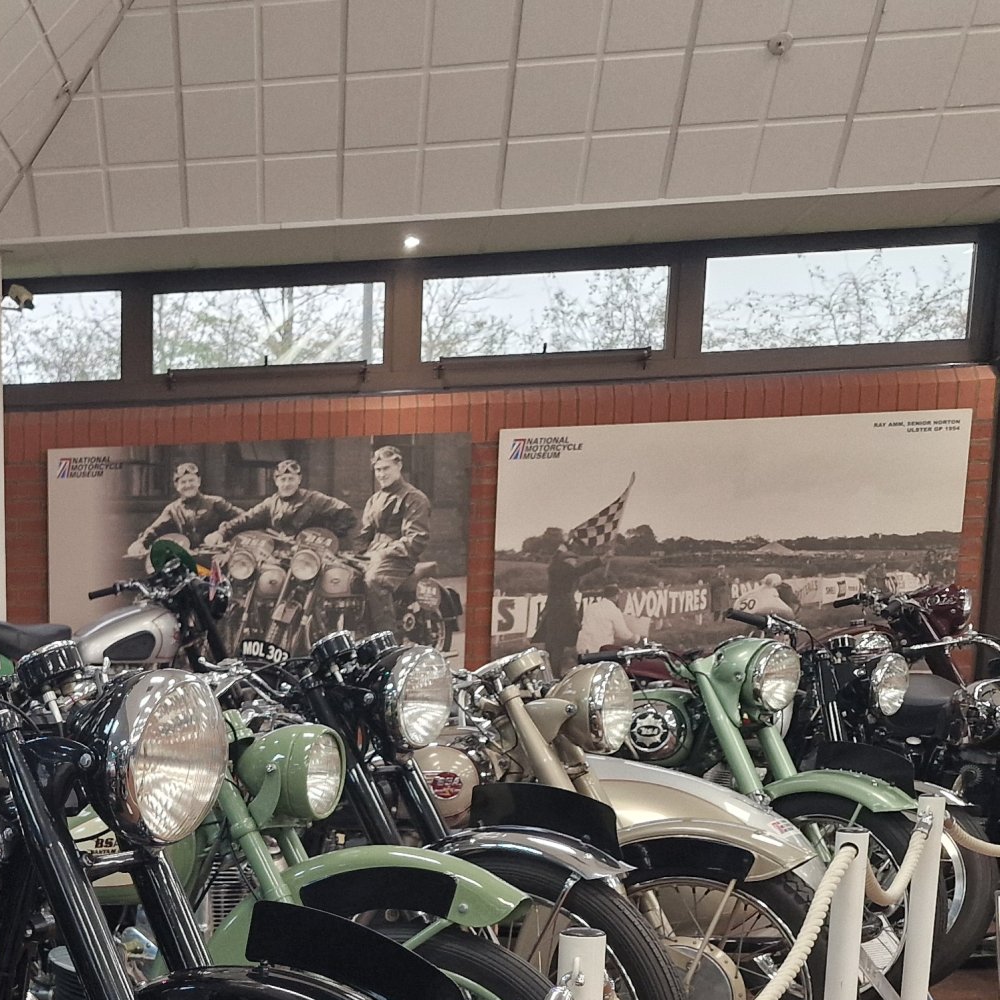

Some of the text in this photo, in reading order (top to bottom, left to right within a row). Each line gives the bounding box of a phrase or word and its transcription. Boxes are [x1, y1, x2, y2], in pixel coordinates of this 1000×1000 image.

[527, 436, 569, 444] NATIONAL
[525, 443, 583, 452] MOTORCYCLE
[72, 456, 111, 464] NATIONAL
[623, 590, 669, 617] AVON
[669, 588, 708, 614] TYRES
[740, 599, 756, 610] 50
[243, 641, 265, 657] MOL
